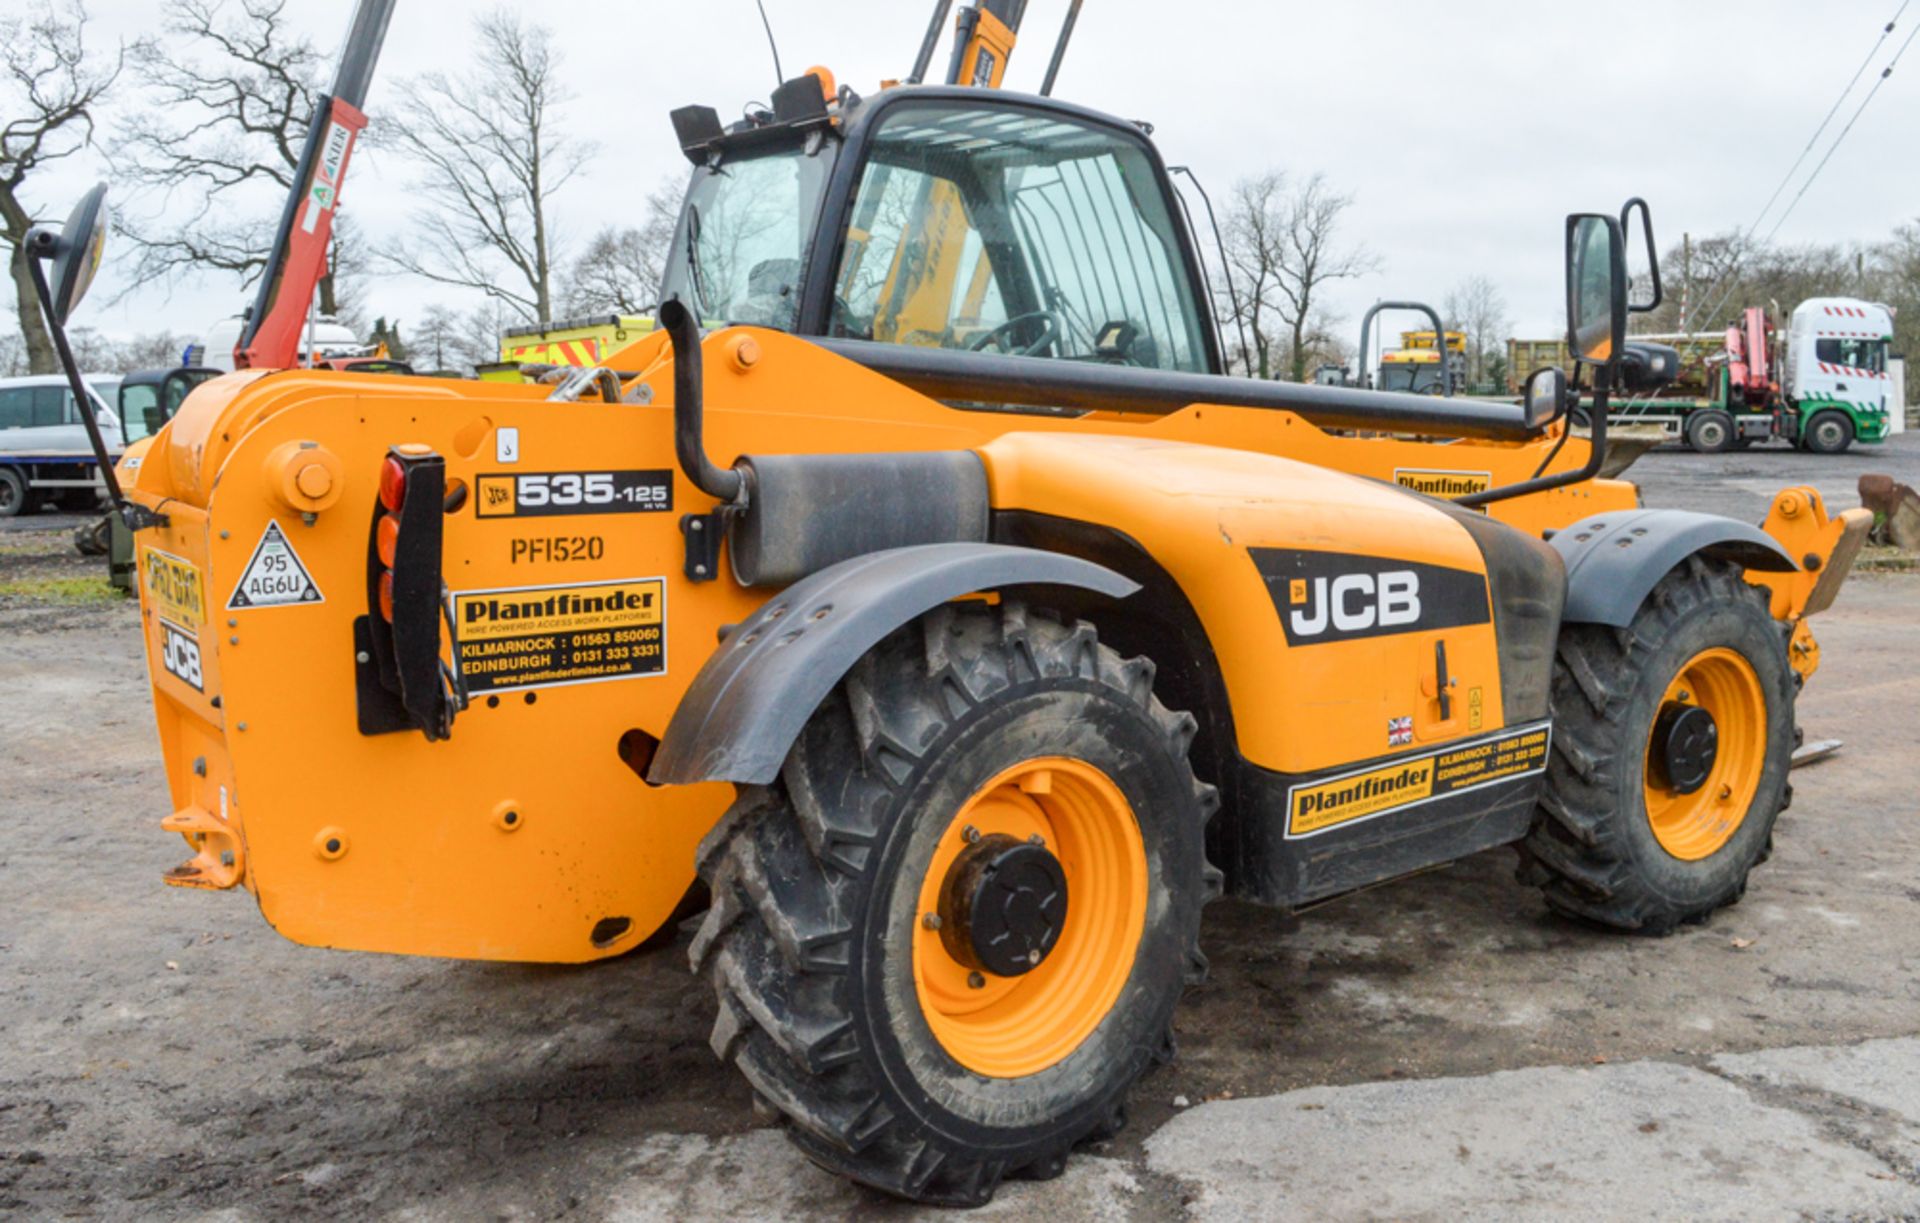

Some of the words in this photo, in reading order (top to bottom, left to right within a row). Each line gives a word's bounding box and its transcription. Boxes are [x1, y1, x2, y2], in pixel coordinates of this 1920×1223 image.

[327, 127, 347, 167] KIER
[517, 473, 667, 506] 535-125
[263, 554, 287, 573] 95
[250, 575, 299, 595] AG6U
[465, 591, 654, 623] Plantfinder
[1290, 570, 1421, 636] JCB
[489, 621, 535, 633] POWERED
[537, 617, 573, 629] ACCESS
[574, 615, 601, 625] WORK
[602, 611, 652, 623] PLATFORMS
[164, 628, 203, 689] JCB
[462, 636, 556, 658] KILMARNOCK
[572, 632, 610, 647] 01563
[614, 628, 660, 643] 850060
[462, 653, 551, 675] EDINBURGH
[572, 649, 602, 663] 0131
[606, 646, 629, 660] 333
[632, 643, 660, 658] 3331
[1299, 768, 1429, 816] Plantfinder
